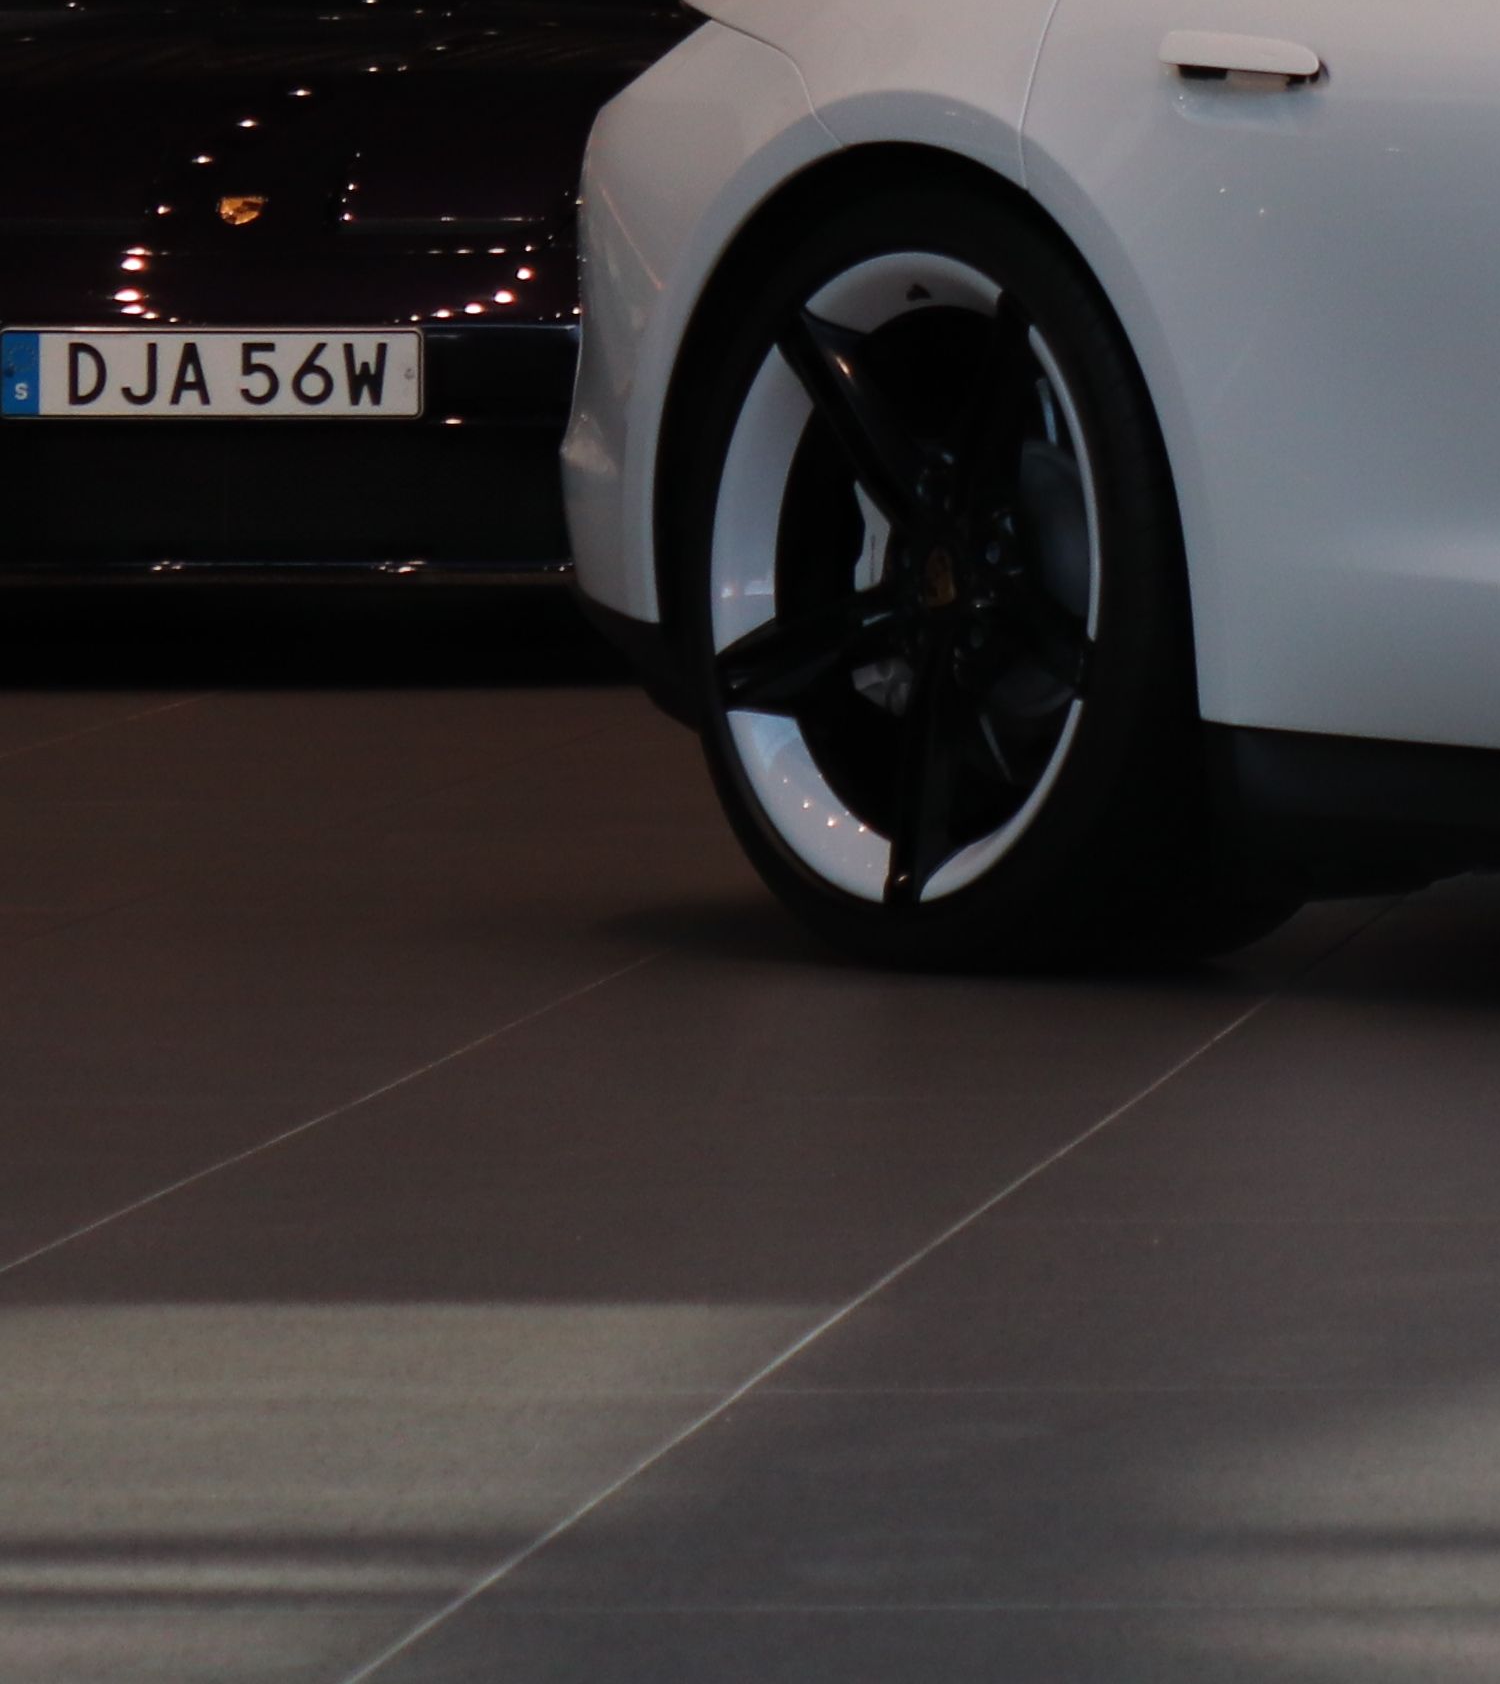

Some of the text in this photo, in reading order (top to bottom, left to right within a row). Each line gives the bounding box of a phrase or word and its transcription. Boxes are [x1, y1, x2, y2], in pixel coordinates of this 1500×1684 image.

[14, 383, 28, 400] S
[67, 342, 389, 406] DJA 56W
